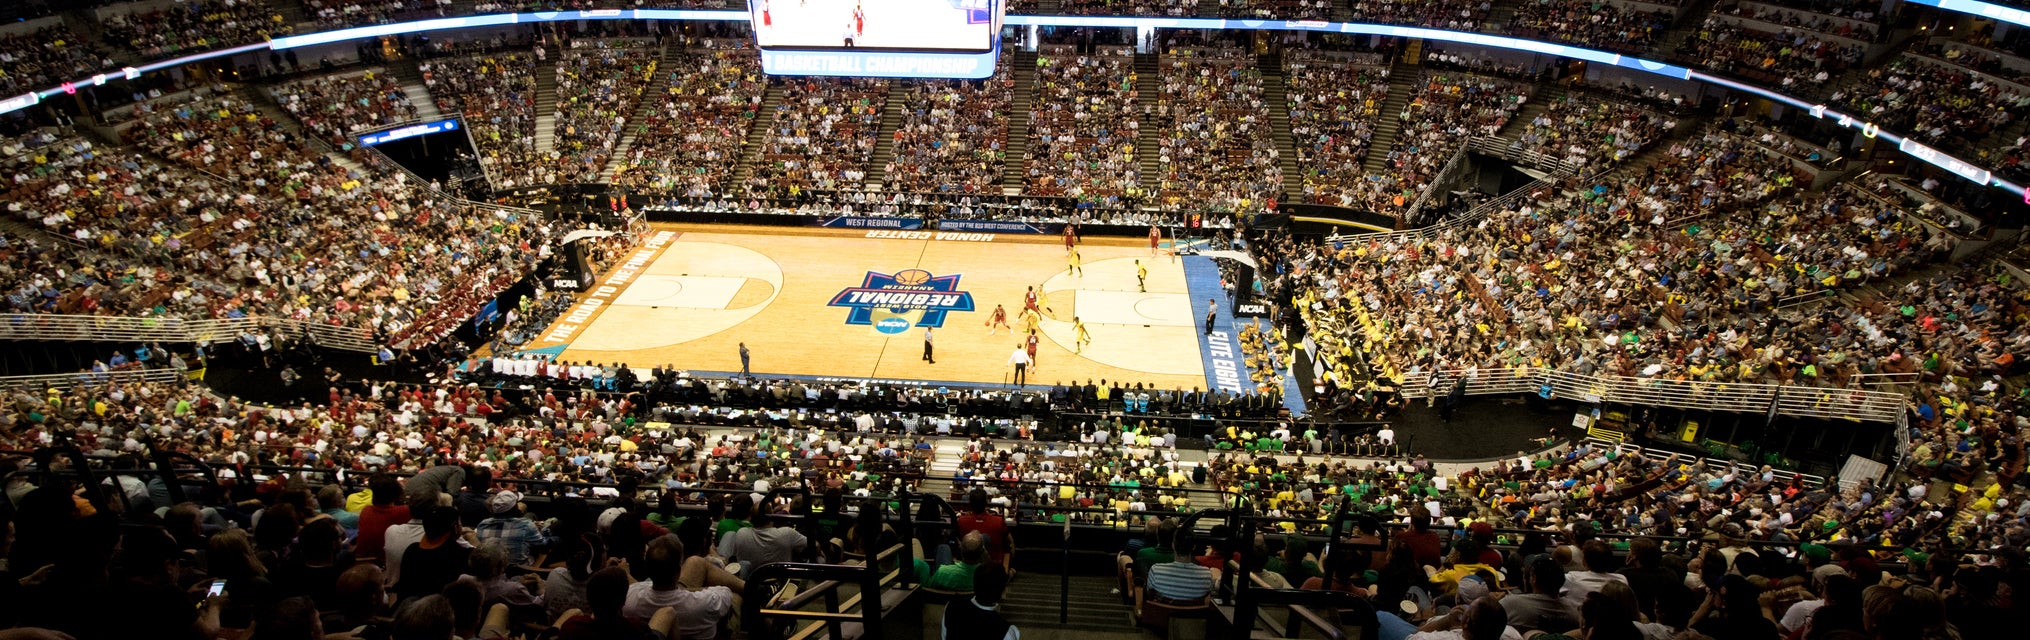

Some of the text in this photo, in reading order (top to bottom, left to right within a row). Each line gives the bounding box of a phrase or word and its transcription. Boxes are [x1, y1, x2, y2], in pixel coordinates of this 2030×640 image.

[775, 54, 861, 73] BASKETBALL
[865, 56, 978, 75] CHAMPIONSHIP
[845, 218, 902, 228] WEST REGIONAL
[984, 222, 997, 230] WEST
[997, 223, 1026, 231] CONFERENCE
[865, 230, 996, 242] HONDA CENTER
[543, 230, 676, 343] THE ROAD TO THE FINAL FOUR
[553, 279, 578, 289] NCAA
[848, 291, 960, 307] REGIONAL
[1238, 304, 1266, 314] NCAA
[1207, 331, 1242, 394] ELITE EIGHT
